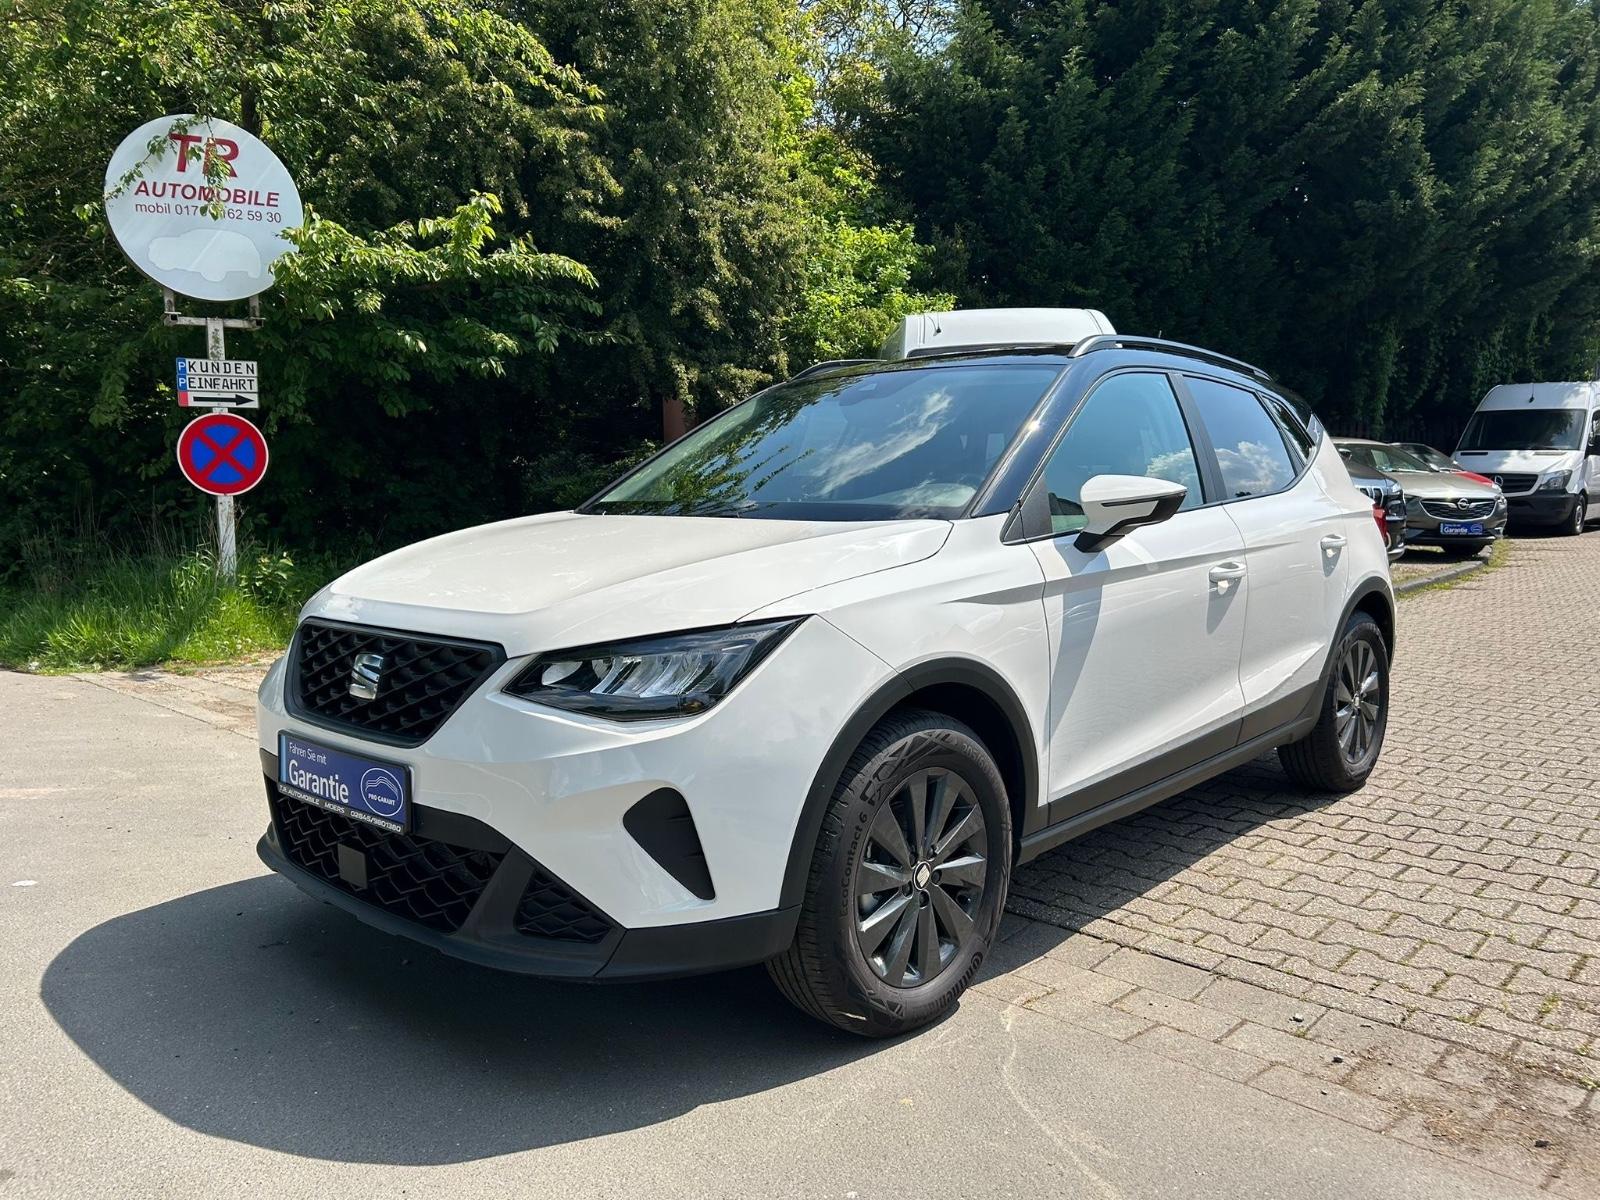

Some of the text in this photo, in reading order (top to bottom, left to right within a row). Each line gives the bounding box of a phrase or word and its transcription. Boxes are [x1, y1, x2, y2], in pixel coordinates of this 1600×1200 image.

[168, 132, 240, 178] TR
[134, 180, 280, 208] AUTOMOBILE
[135, 202, 171, 214] mobil
[247, 209, 263, 222] 59
[266, 211, 282, 224] 30
[188, 360, 255, 375] KUNDEN
[188, 376, 255, 391] EINFAHRT
[289, 742, 327, 765] Fahren Sie mit
[288, 759, 349, 804] Garantie
[288, 789, 320, 805] AUTOMOBILE
[324, 801, 345, 814] MOERS
[368, 793, 378, 801] PRO
[838, 825, 864, 918] EcoContact
